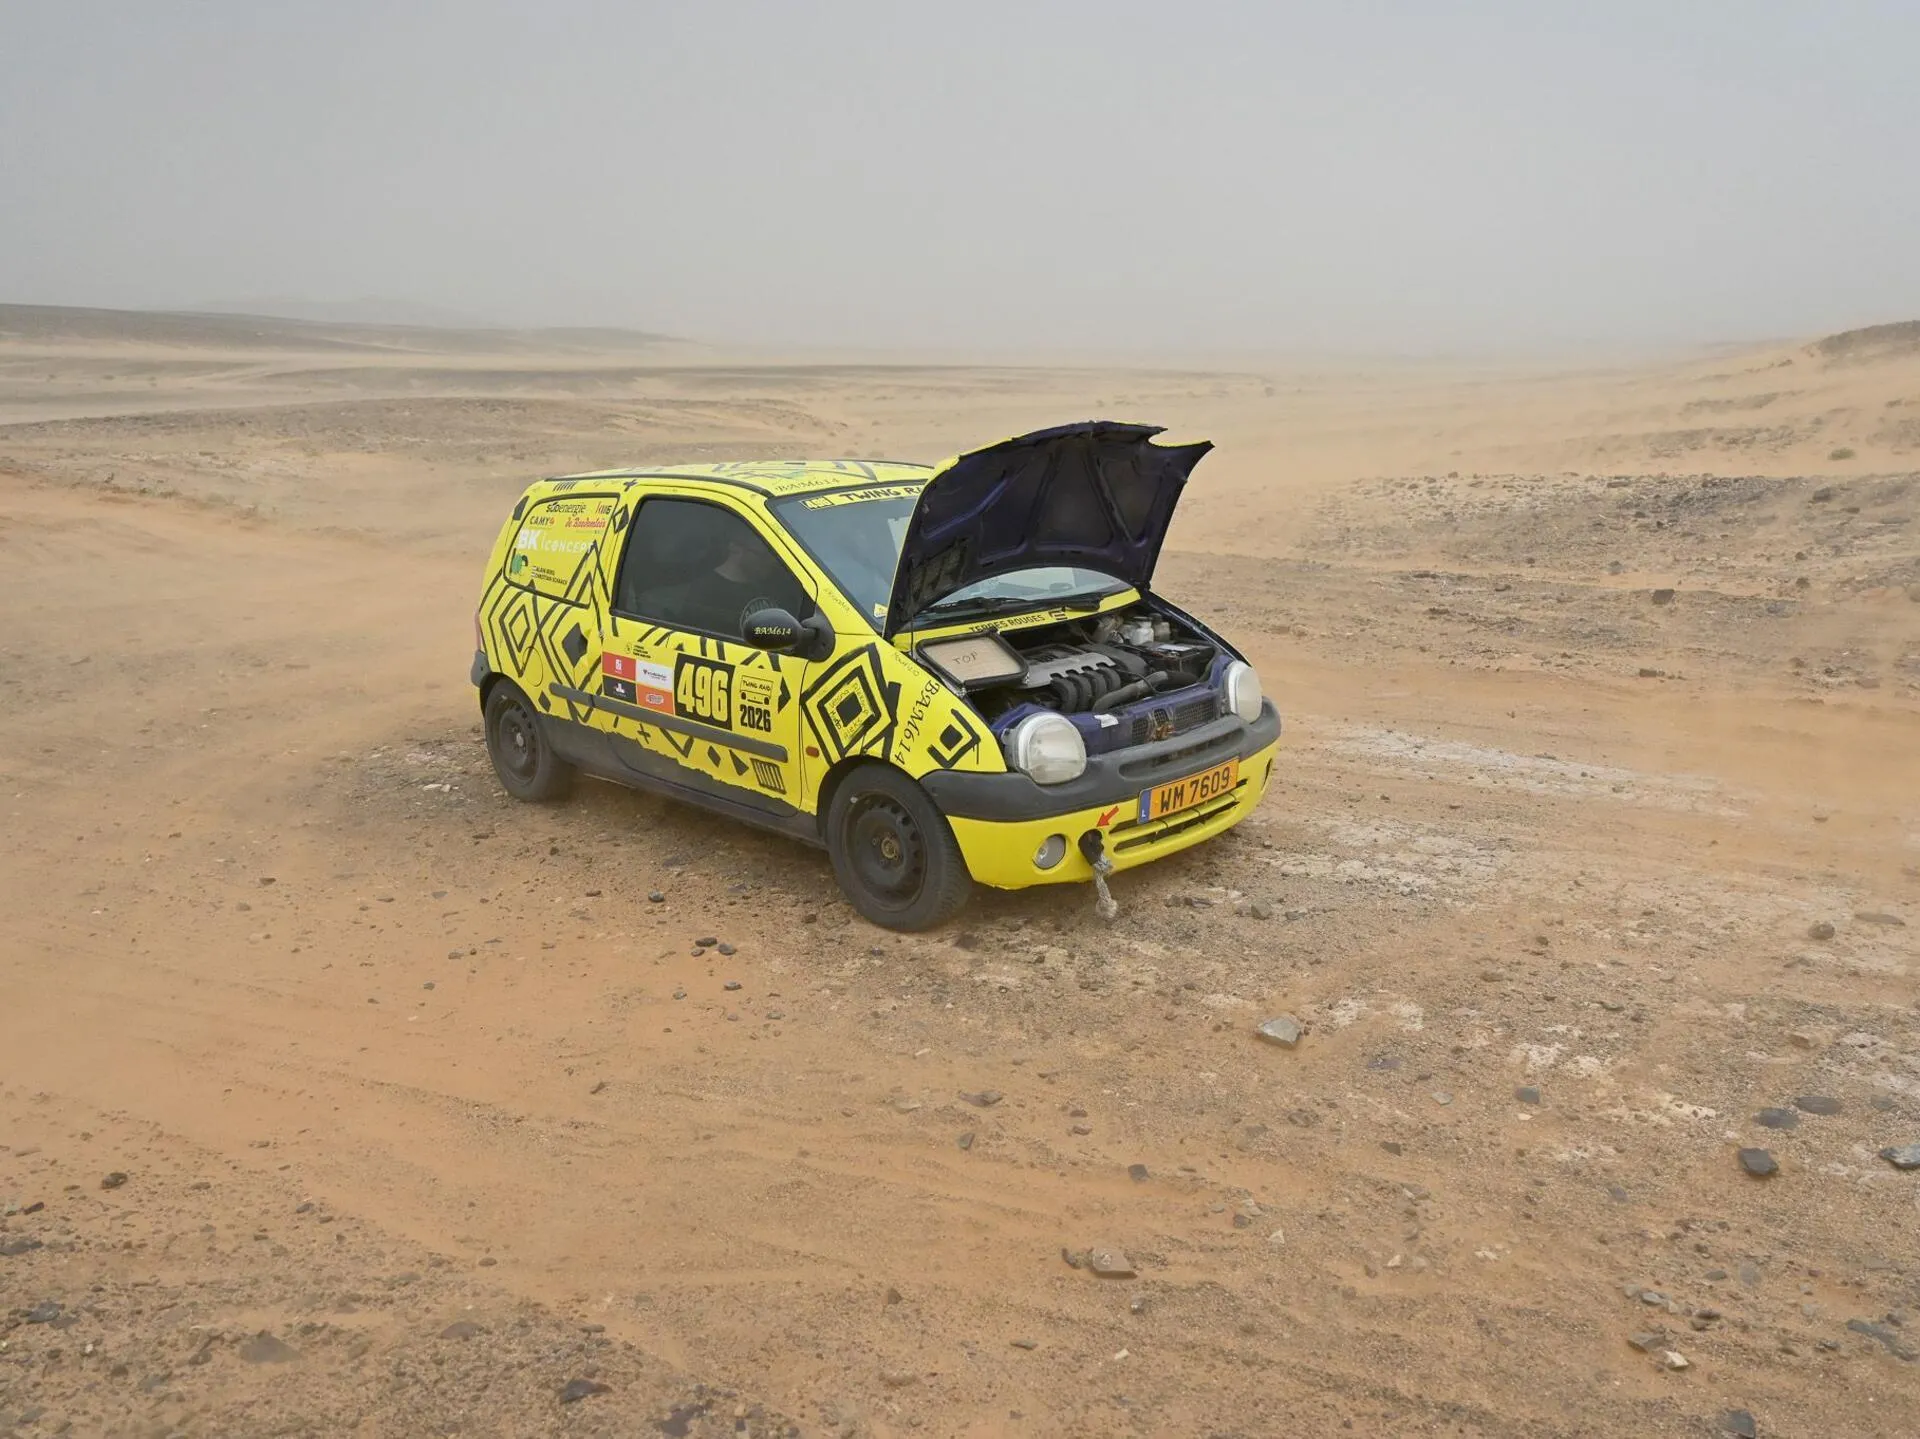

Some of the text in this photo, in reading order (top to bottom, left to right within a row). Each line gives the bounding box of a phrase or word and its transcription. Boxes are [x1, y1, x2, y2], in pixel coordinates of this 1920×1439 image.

[839, 488, 901, 501] TWING
[517, 528, 542, 550] BK
[754, 626, 792, 636] BAM614
[1009, 614, 1045, 628] ROUGES
[677, 662, 729, 722] 496
[743, 680, 771, 692] TWING RAID
[740, 704, 771, 733] 2026
[894, 680, 941, 766] BAM614
[1160, 766, 1231, 813] WM 7609
